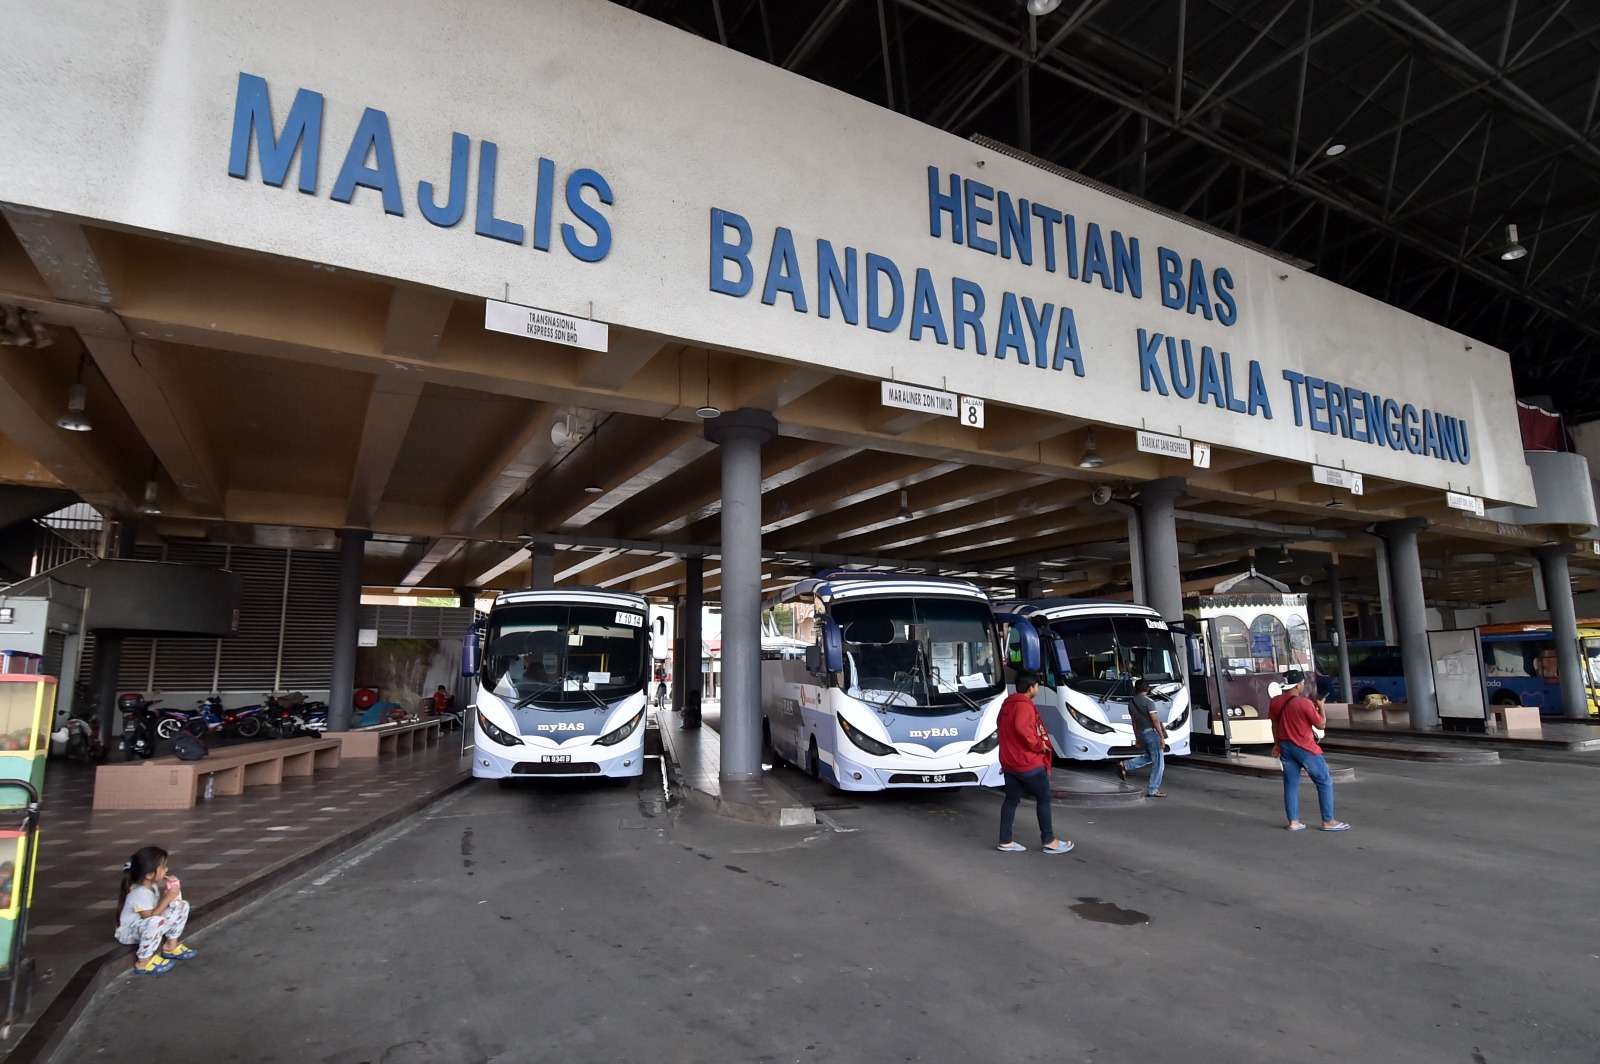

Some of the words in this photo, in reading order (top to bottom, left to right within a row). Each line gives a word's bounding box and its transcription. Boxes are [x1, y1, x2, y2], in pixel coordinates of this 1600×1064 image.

[928, 165, 1143, 299] HENTIAN
[1158, 246, 1238, 326] BAS
[227, 71, 615, 264] MAJLIS
[709, 206, 1086, 377] BANDARAYA
[1136, 328, 1273, 419] KUALA
[1283, 369, 1471, 465] TERENGGANU
[529, 312, 576, 331] TRANSNASIONAL
[526, 323, 553, 338] EKSPRESS
[554, 329, 566, 340] SDN
[566, 332, 578, 342] BHD
[888, 388, 921, 405] MARALINER
[923, 394, 935, 408] ZON
[936, 396, 952, 411] TIMUR
[968, 406, 978, 424] 8
[1199, 450, 1204, 466] 7
[1354, 479, 1360, 493] 6
[537, 722, 584, 732] myBAS
[909, 727, 958, 739] myBAS
